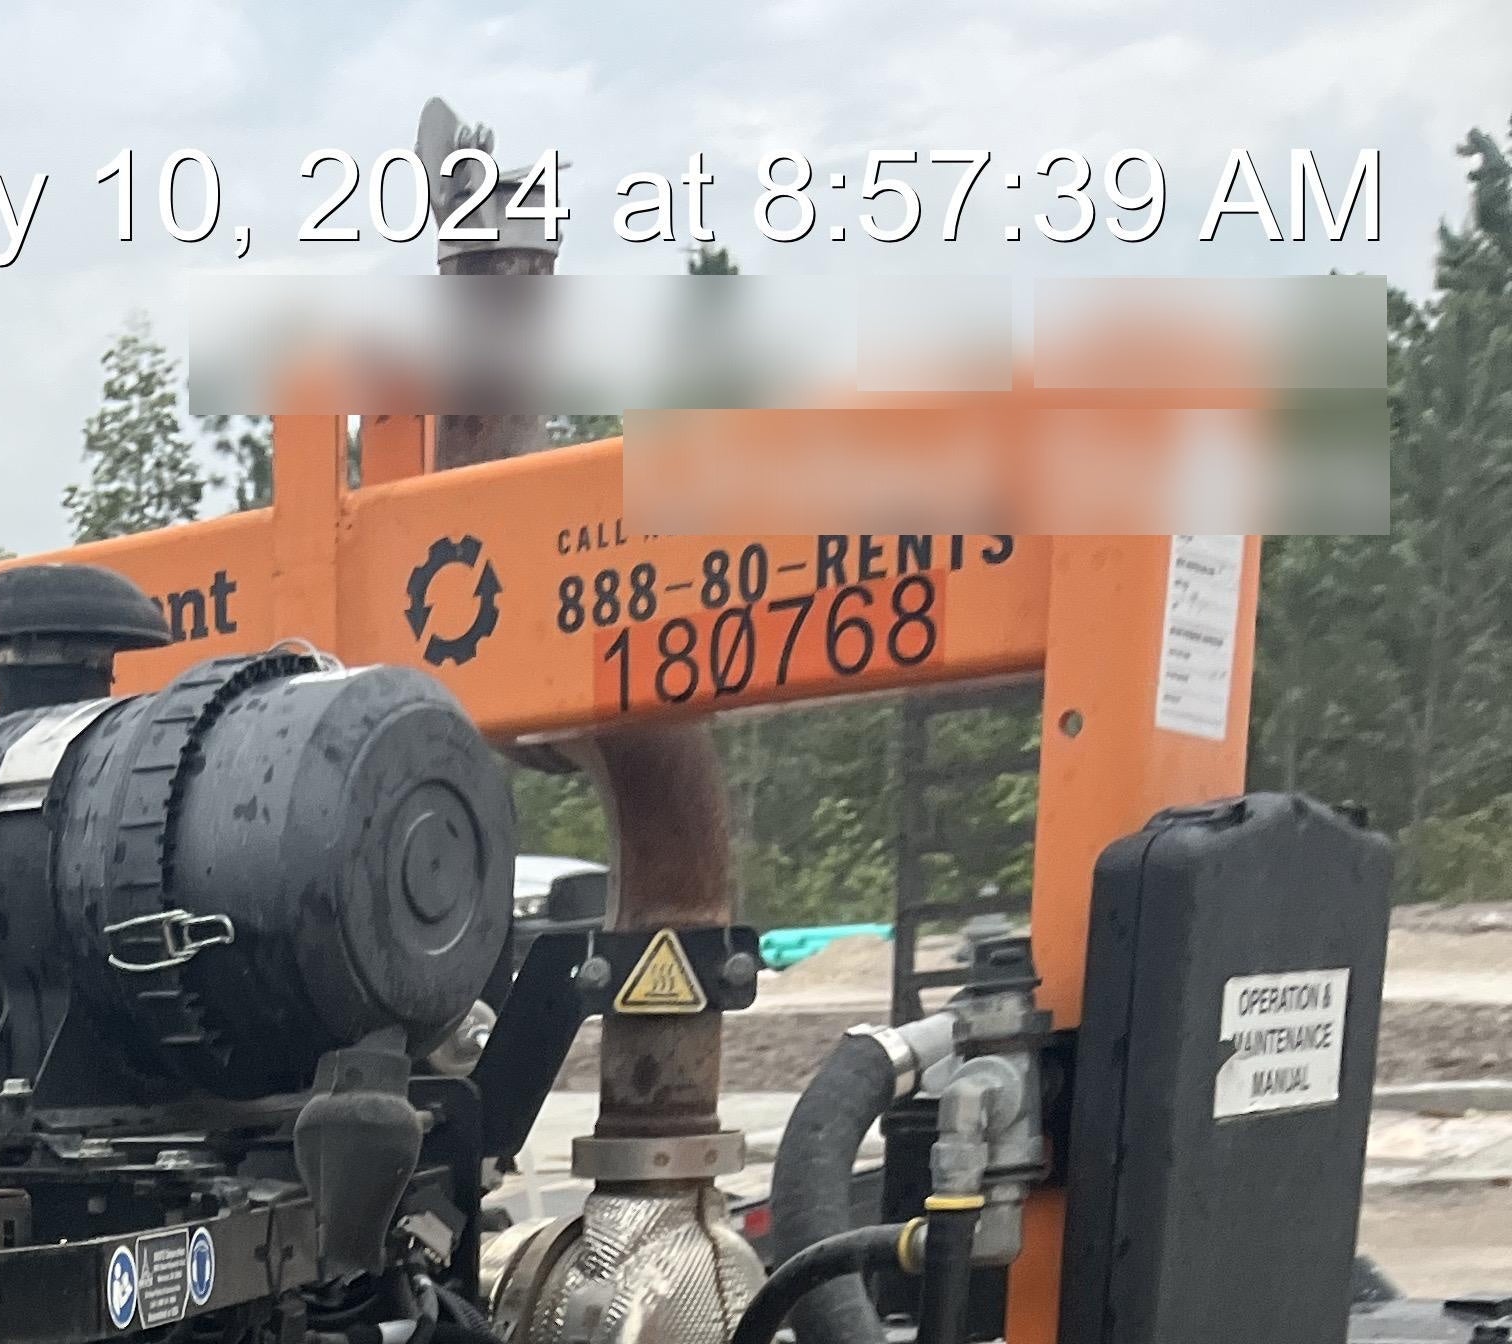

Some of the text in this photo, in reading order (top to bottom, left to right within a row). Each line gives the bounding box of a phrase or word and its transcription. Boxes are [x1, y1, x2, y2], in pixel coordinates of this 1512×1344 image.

[558, 518, 628, 556] CALL
[603, 573, 938, 712] 180768
[1239, 983, 1319, 1017] OPERATION
[1251, 1065, 1310, 1098] MANUAL
